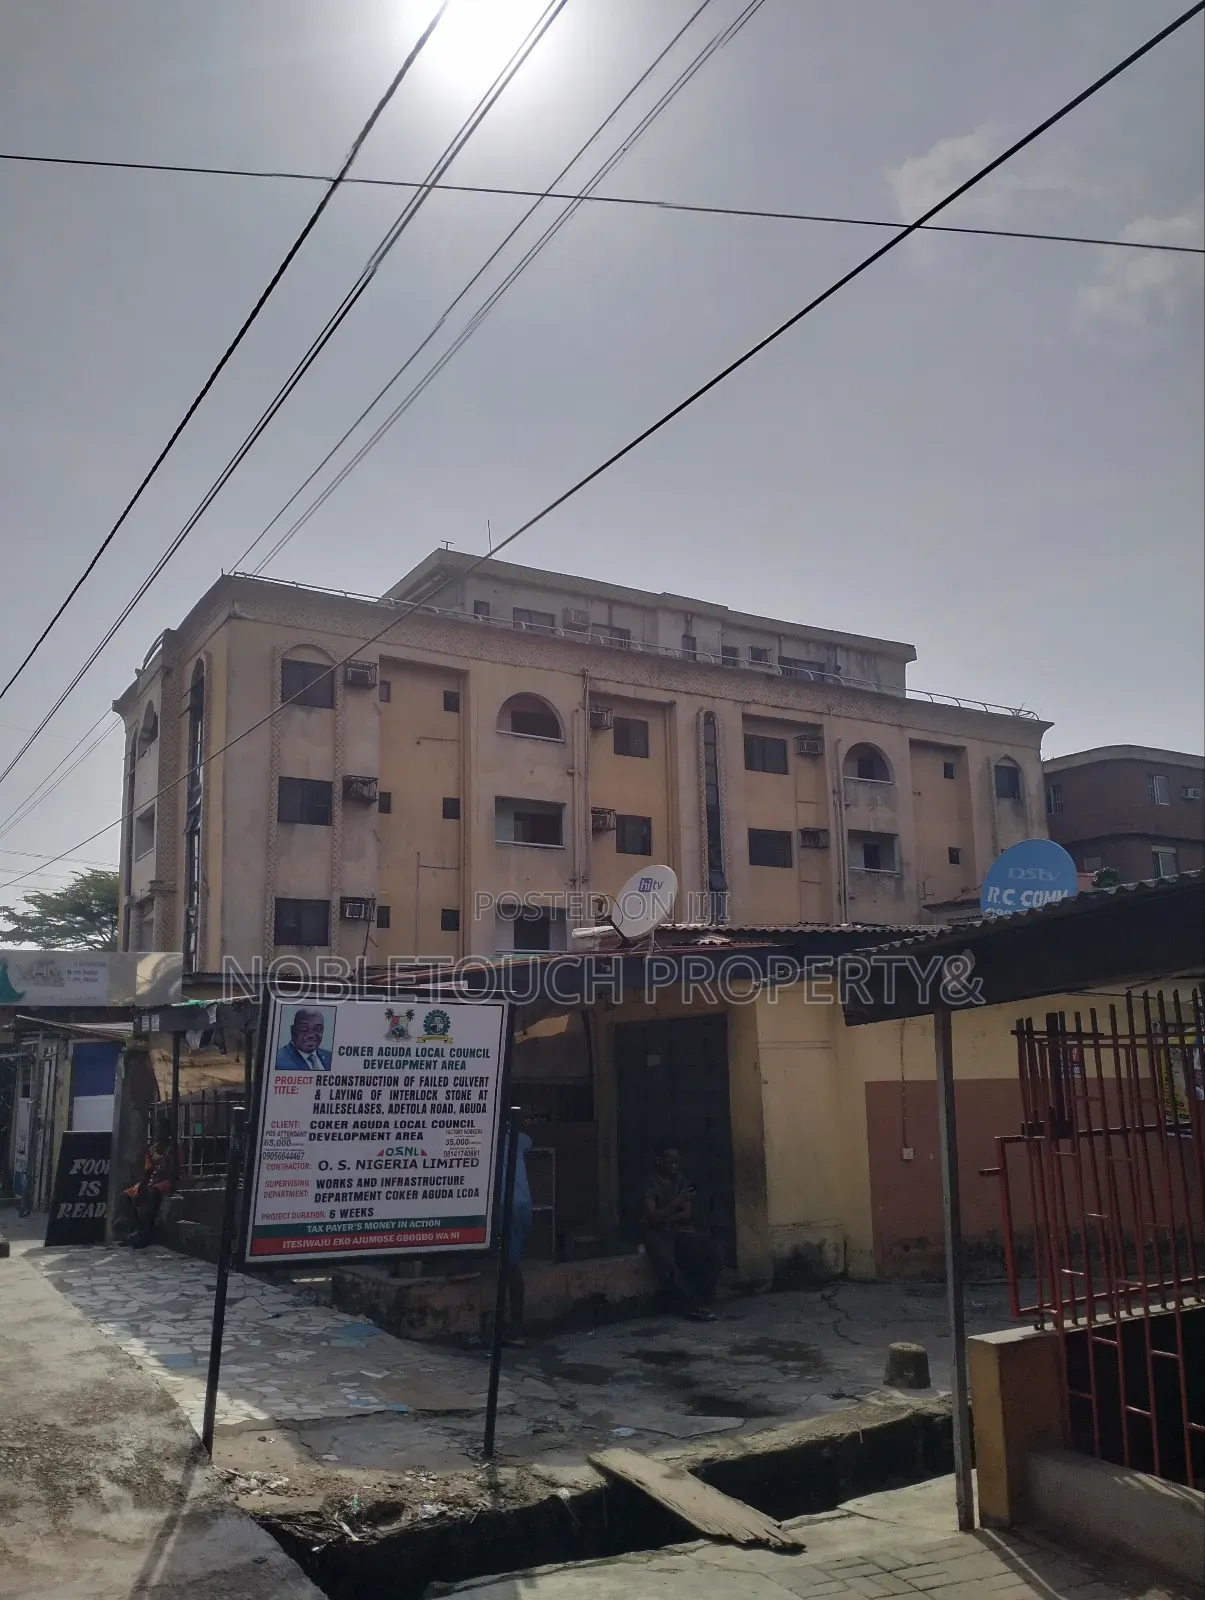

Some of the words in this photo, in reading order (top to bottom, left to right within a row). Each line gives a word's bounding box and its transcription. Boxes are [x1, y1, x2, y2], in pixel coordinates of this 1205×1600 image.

[1008, 867, 1060, 881] DStv
[338, 1046, 374, 1056] COKER
[377, 1047, 412, 1057] AGUDA
[416, 1048, 445, 1058] LOCAL
[449, 1048, 491, 1058] COUNCIL
[363, 1060, 438, 1070] DEVELOPMENT
[441, 1061, 467, 1070] AREA
[315, 1075, 399, 1087] RECONSTRUCTION
[404, 1077, 416, 1087] OF
[419, 1077, 448, 1087] FAILED
[453, 1077, 489, 1087] CULVERT
[274, 1086, 299, 1094] TITLE:
[315, 1090, 321, 1100] &
[329, 1089, 363, 1100] LAYING
[370, 1090, 383, 1100] OF
[389, 1090, 438, 1100] INTERLOCK
[445, 1090, 472, 1100] STONE
[478, 1090, 488, 1100] AT
[312, 1103, 384, 1115] HAILESELASES,
[388, 1103, 427, 1114] ADETOLA
[430, 1103, 456, 1115] ROAD,
[459, 1103, 486, 1114] AGUDA
[271, 1120, 300, 1128] CLIENT:
[310, 1120, 348, 1129] COKER
[352, 1120, 390, 1129] AGUDA
[394, 1120, 427, 1129] LOCAL
[431, 1120, 475, 1128] COUNCIL
[308, 1132, 391, 1141] DEVELOPMENT
[395, 1132, 424, 1140] AREA
[267, 1162, 312, 1170] CONTRACTOR:
[318, 1160, 333, 1171] O.
[338, 1160, 351, 1170] S.
[356, 1159, 418, 1170] NIGERIA
[423, 1158, 480, 1169] LIMITED
[265, 1179, 310, 1188] SUPERVISING
[316, 1178, 353, 1189] WORKS
[357, 1178, 378, 1188] AND
[380, 1176, 465, 1187] INFRASTRUCTURE
[78, 1181, 101, 1197] IS
[264, 1190, 309, 1198] DEPARTMENT:
[315, 1191, 382, 1203] DEPARTMENT
[386, 1190, 419, 1200] COKER
[422, 1189, 453, 1200] AGUDA
[457, 1188, 479, 1198] LCDA
[56, 1203, 108, 1219] READ
[262, 1212, 291, 1221] PROJECT
[292, 1211, 327, 1219] DURATION:
[329, 1209, 336, 1219] 6
[340, 1207, 374, 1218] WEEKS
[307, 1224, 324, 1233] TAX
[326, 1223, 362, 1232] PAYER'S
[364, 1221, 396, 1230] MONEY
[397, 1220, 407, 1228] IN
[408, 1219, 441, 1228] ACTION
[283, 1238, 331, 1249] ITESIWAJU
[333, 1238, 351, 1246] EKO
[352, 1235, 394, 1245] AJUMOSE
[396, 1233, 434, 1242] GBOGBO
[450, 1232, 460, 1240] NI
